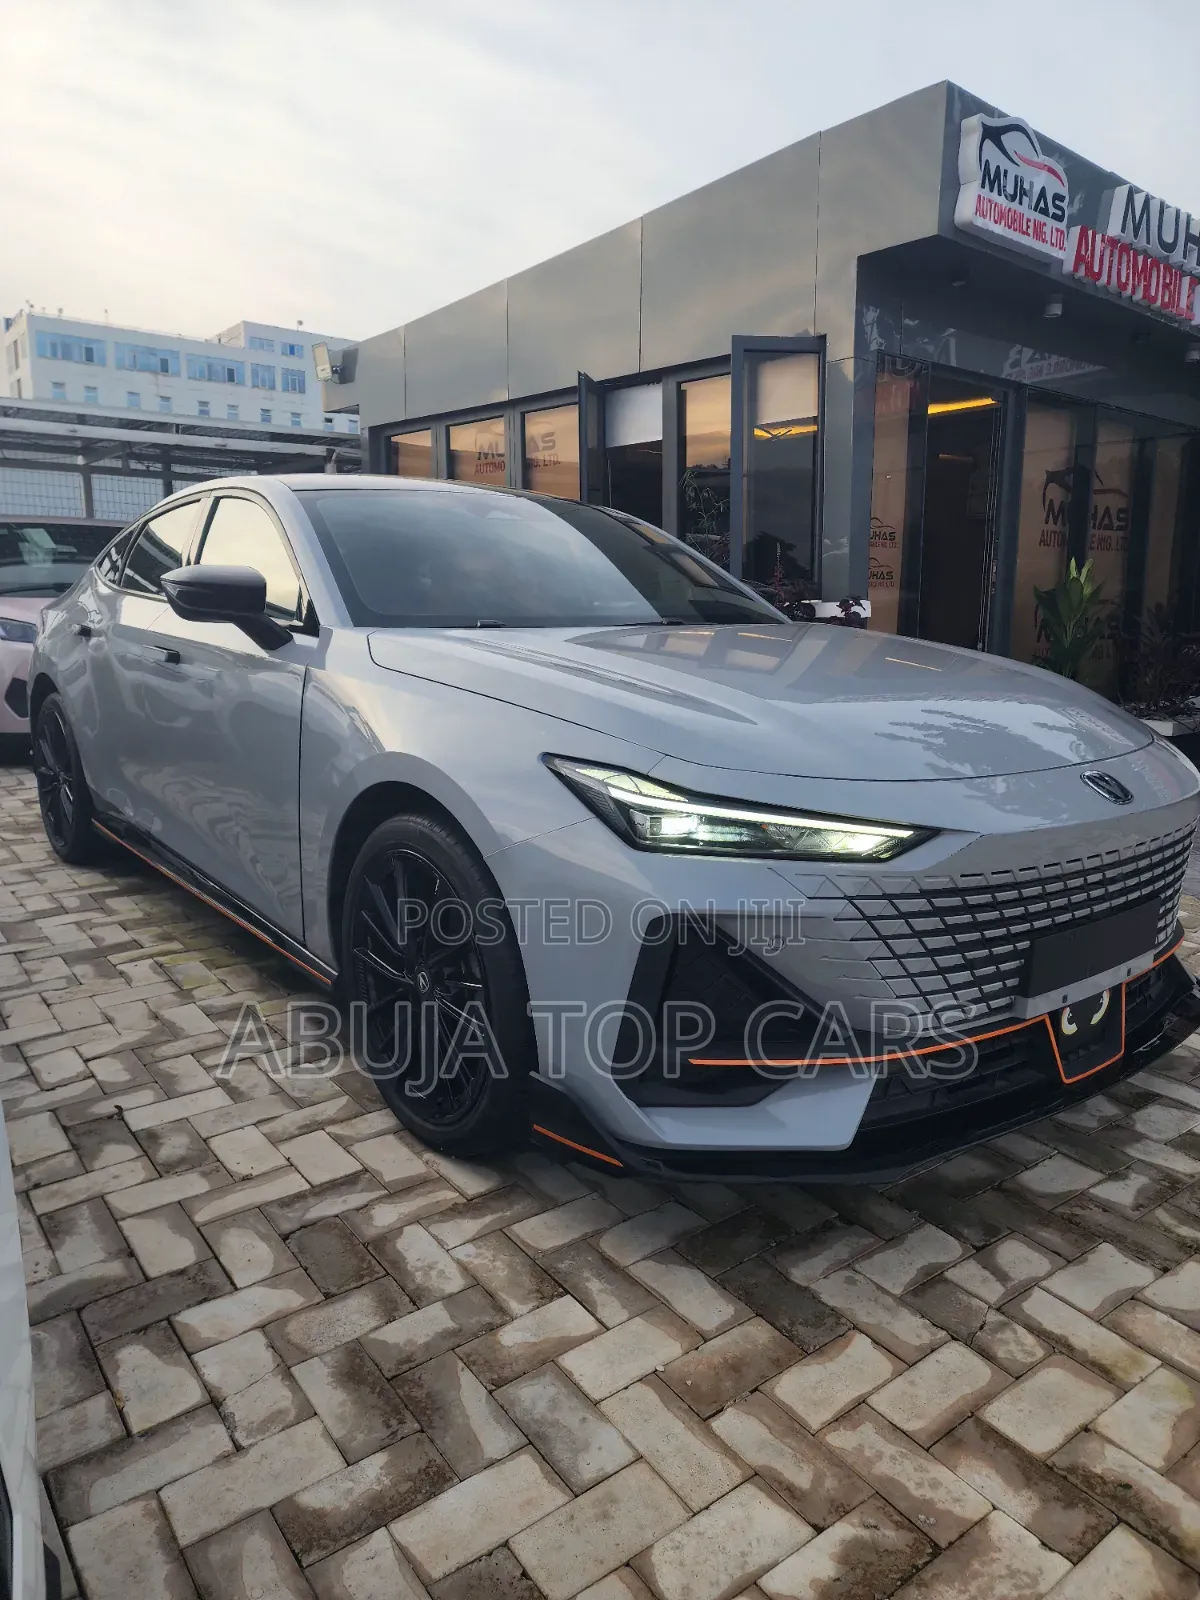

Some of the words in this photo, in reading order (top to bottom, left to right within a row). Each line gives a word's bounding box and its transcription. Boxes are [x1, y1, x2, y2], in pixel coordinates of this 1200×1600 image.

[975, 194, 1031, 237] AUTOMOBILE
[1033, 219, 1048, 244] NIG.
[1050, 226, 1066, 251] LTD.
[981, 159, 1067, 223] MUHAS
[1073, 225, 1199, 320] AUTOMOBILE
